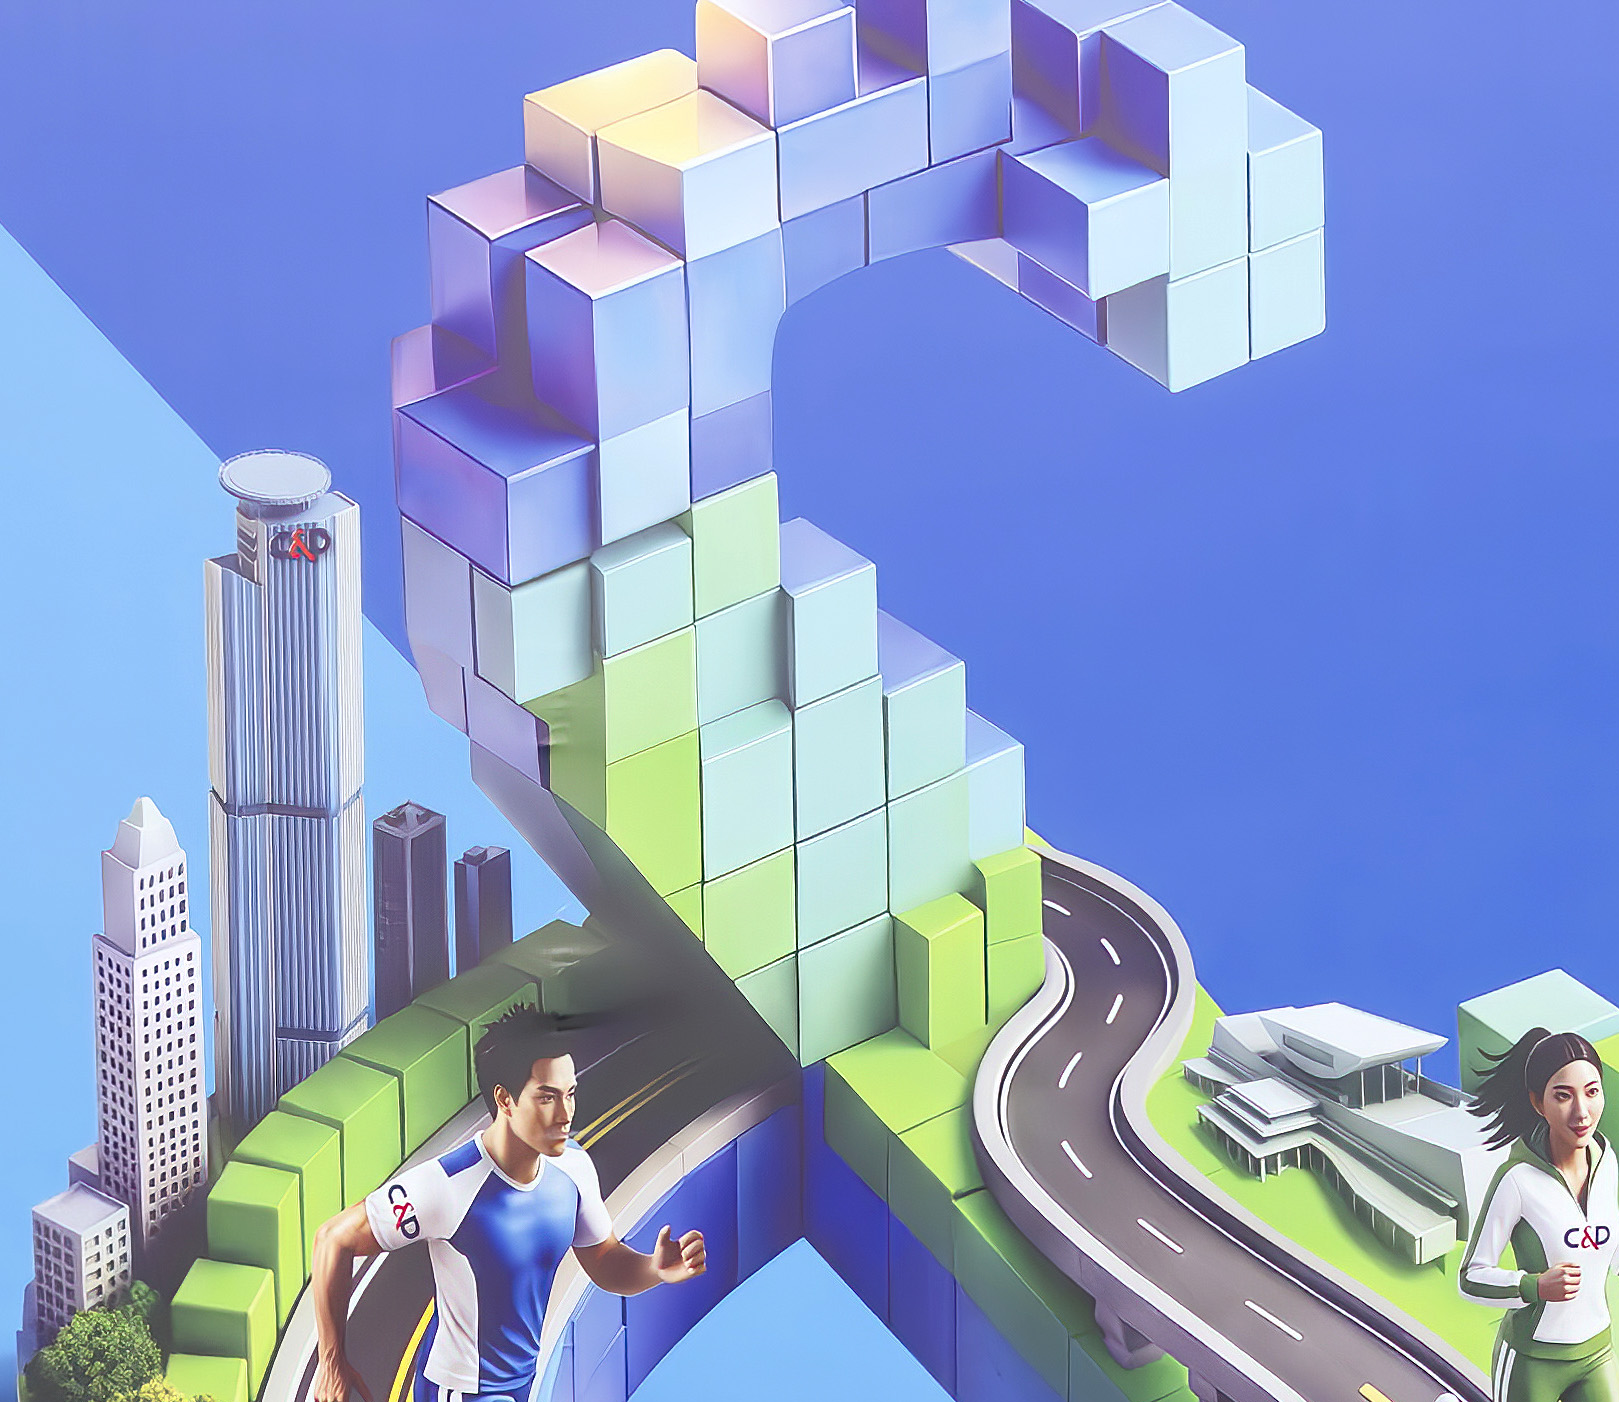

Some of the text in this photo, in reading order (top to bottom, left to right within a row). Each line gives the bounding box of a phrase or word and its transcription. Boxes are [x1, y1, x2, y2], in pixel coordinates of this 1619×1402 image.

[268, 528, 332, 562] C&D
[387, 1184, 421, 1240] C&D
[1563, 1225, 1611, 1250] C&D
